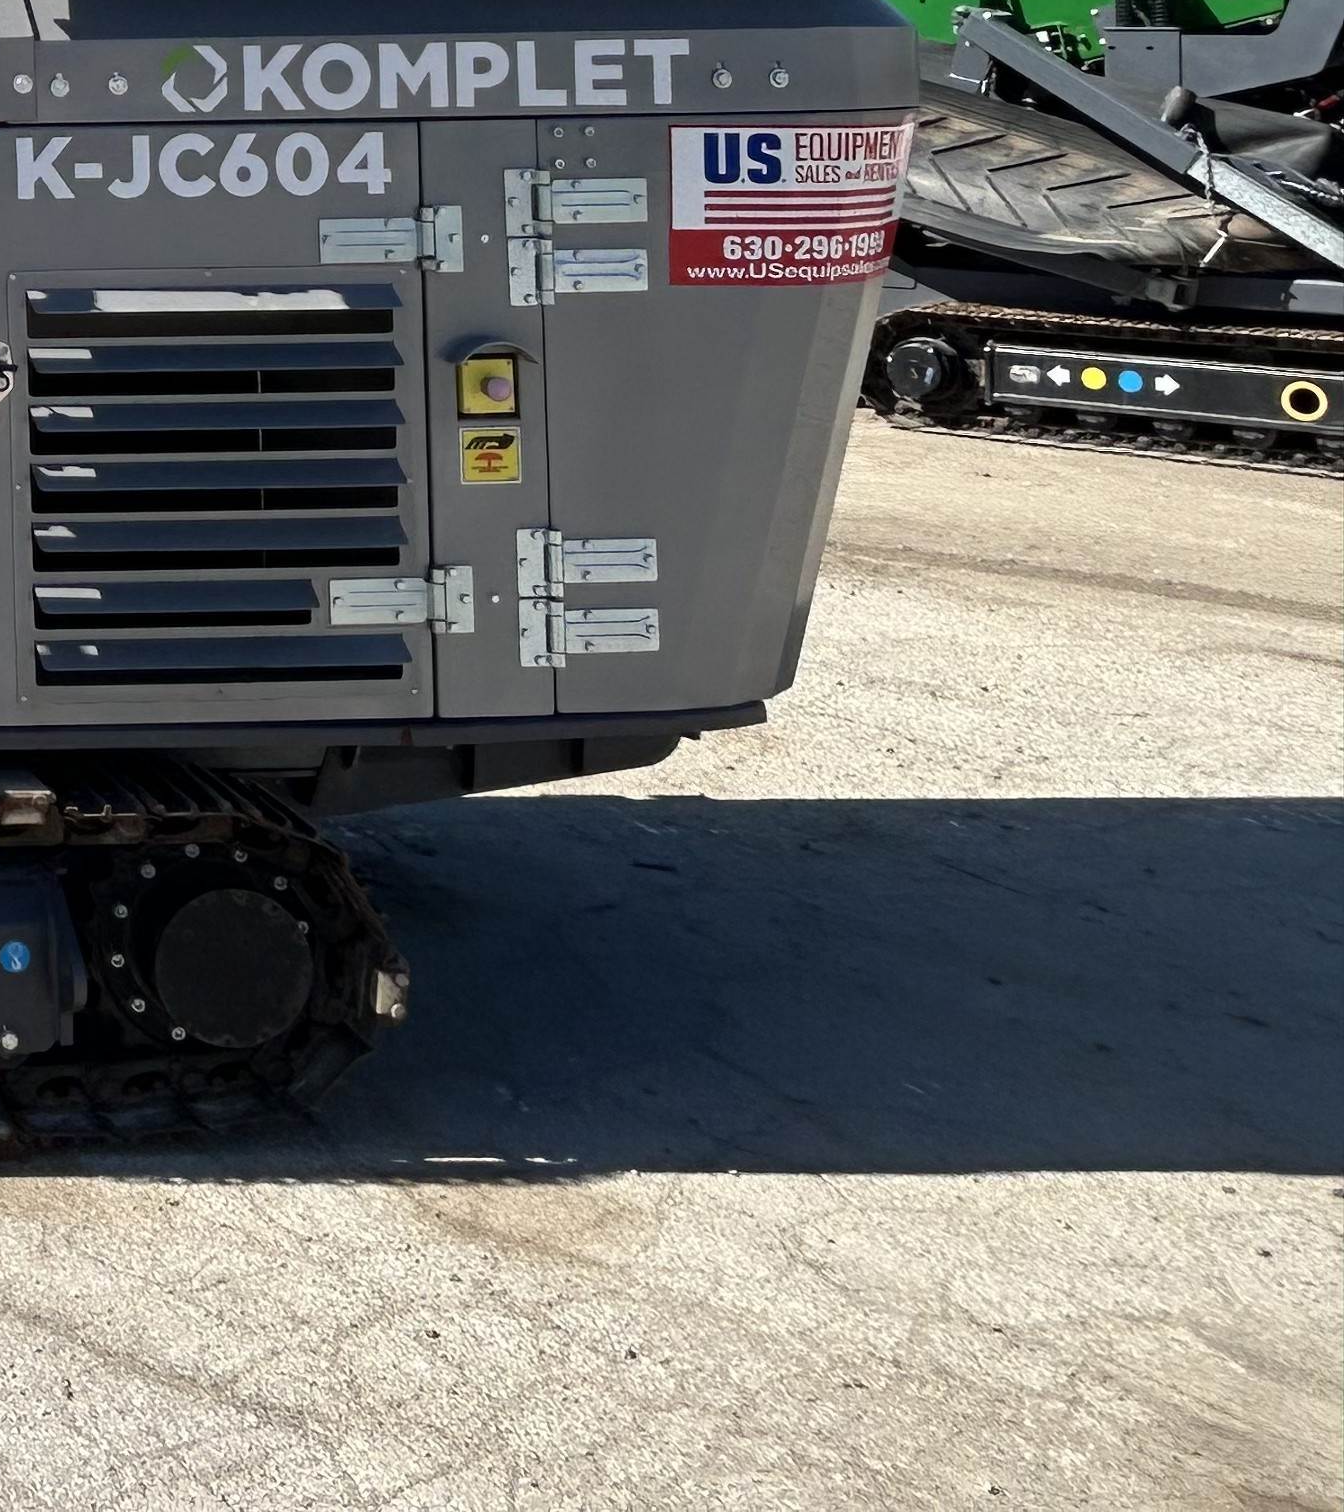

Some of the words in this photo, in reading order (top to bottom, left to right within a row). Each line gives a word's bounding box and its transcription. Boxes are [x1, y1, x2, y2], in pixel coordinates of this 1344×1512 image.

[242, 38, 690, 112] KOMPLET
[16, 132, 392, 200] K-JC604
[795, 165, 841, 183] SALES
